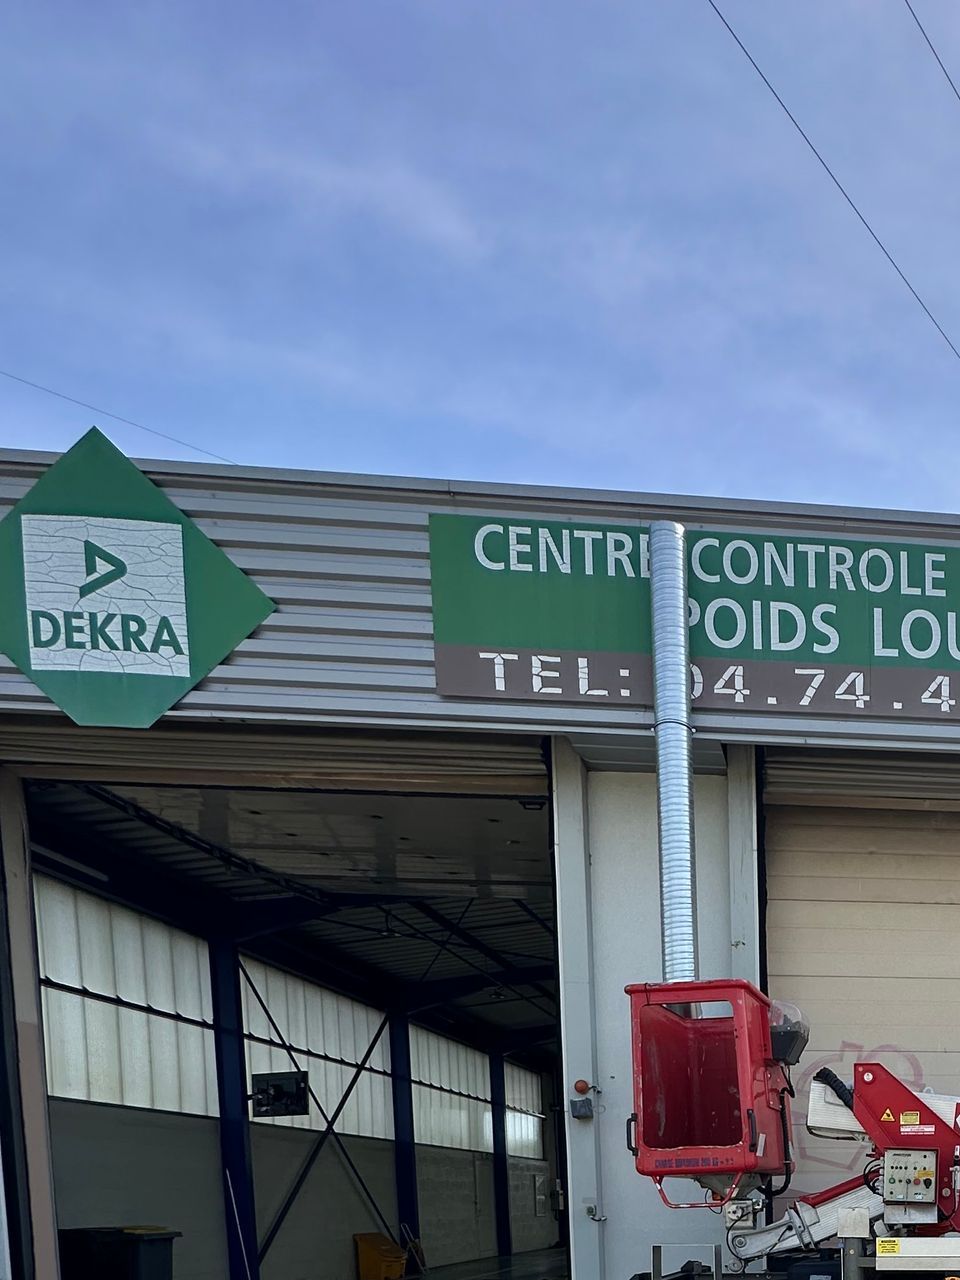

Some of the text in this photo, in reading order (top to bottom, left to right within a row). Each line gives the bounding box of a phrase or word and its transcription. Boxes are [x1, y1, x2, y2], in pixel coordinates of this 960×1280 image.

[691, 537, 947, 598] CONTROLE
[31, 610, 184, 655] DEKRA
[479, 652, 631, 697] TEL:
